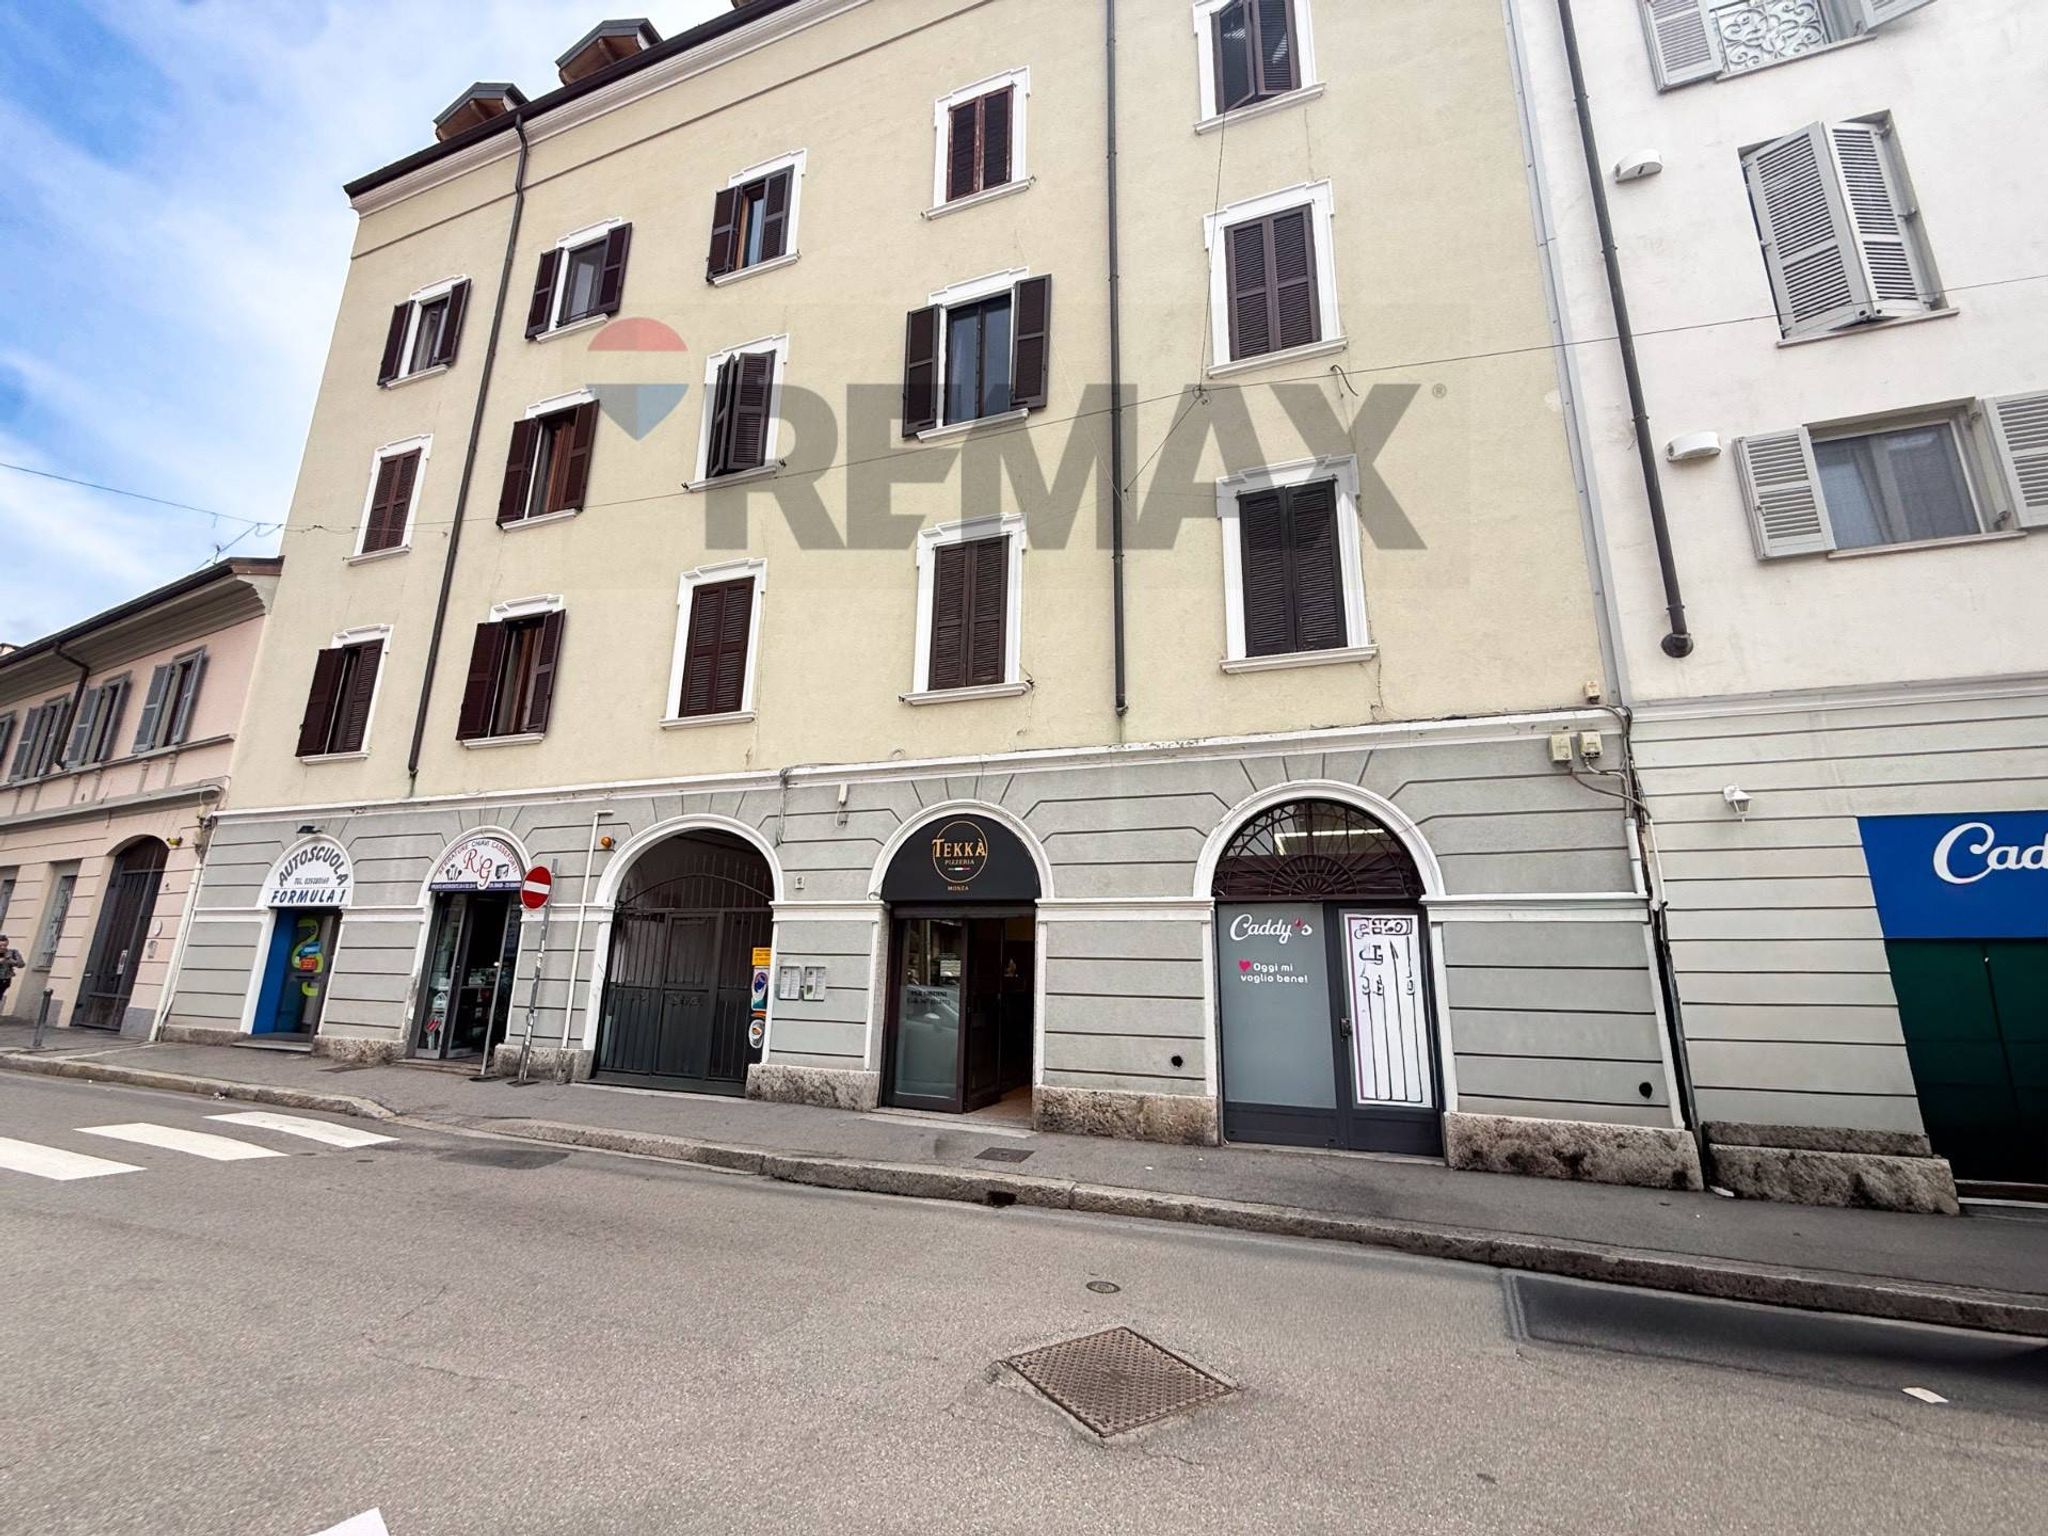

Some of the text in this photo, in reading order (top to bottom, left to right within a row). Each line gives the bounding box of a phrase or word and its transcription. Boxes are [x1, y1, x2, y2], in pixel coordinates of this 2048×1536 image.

[279, 845, 349, 887] AUTOSCUOLA
[270, 889, 336, 904] FORMULA
[1229, 913, 1313, 945] Caddy's
[1252, 962, 1293, 973] Oggi mi
[1240, 974, 1308, 984] voglio bene!
